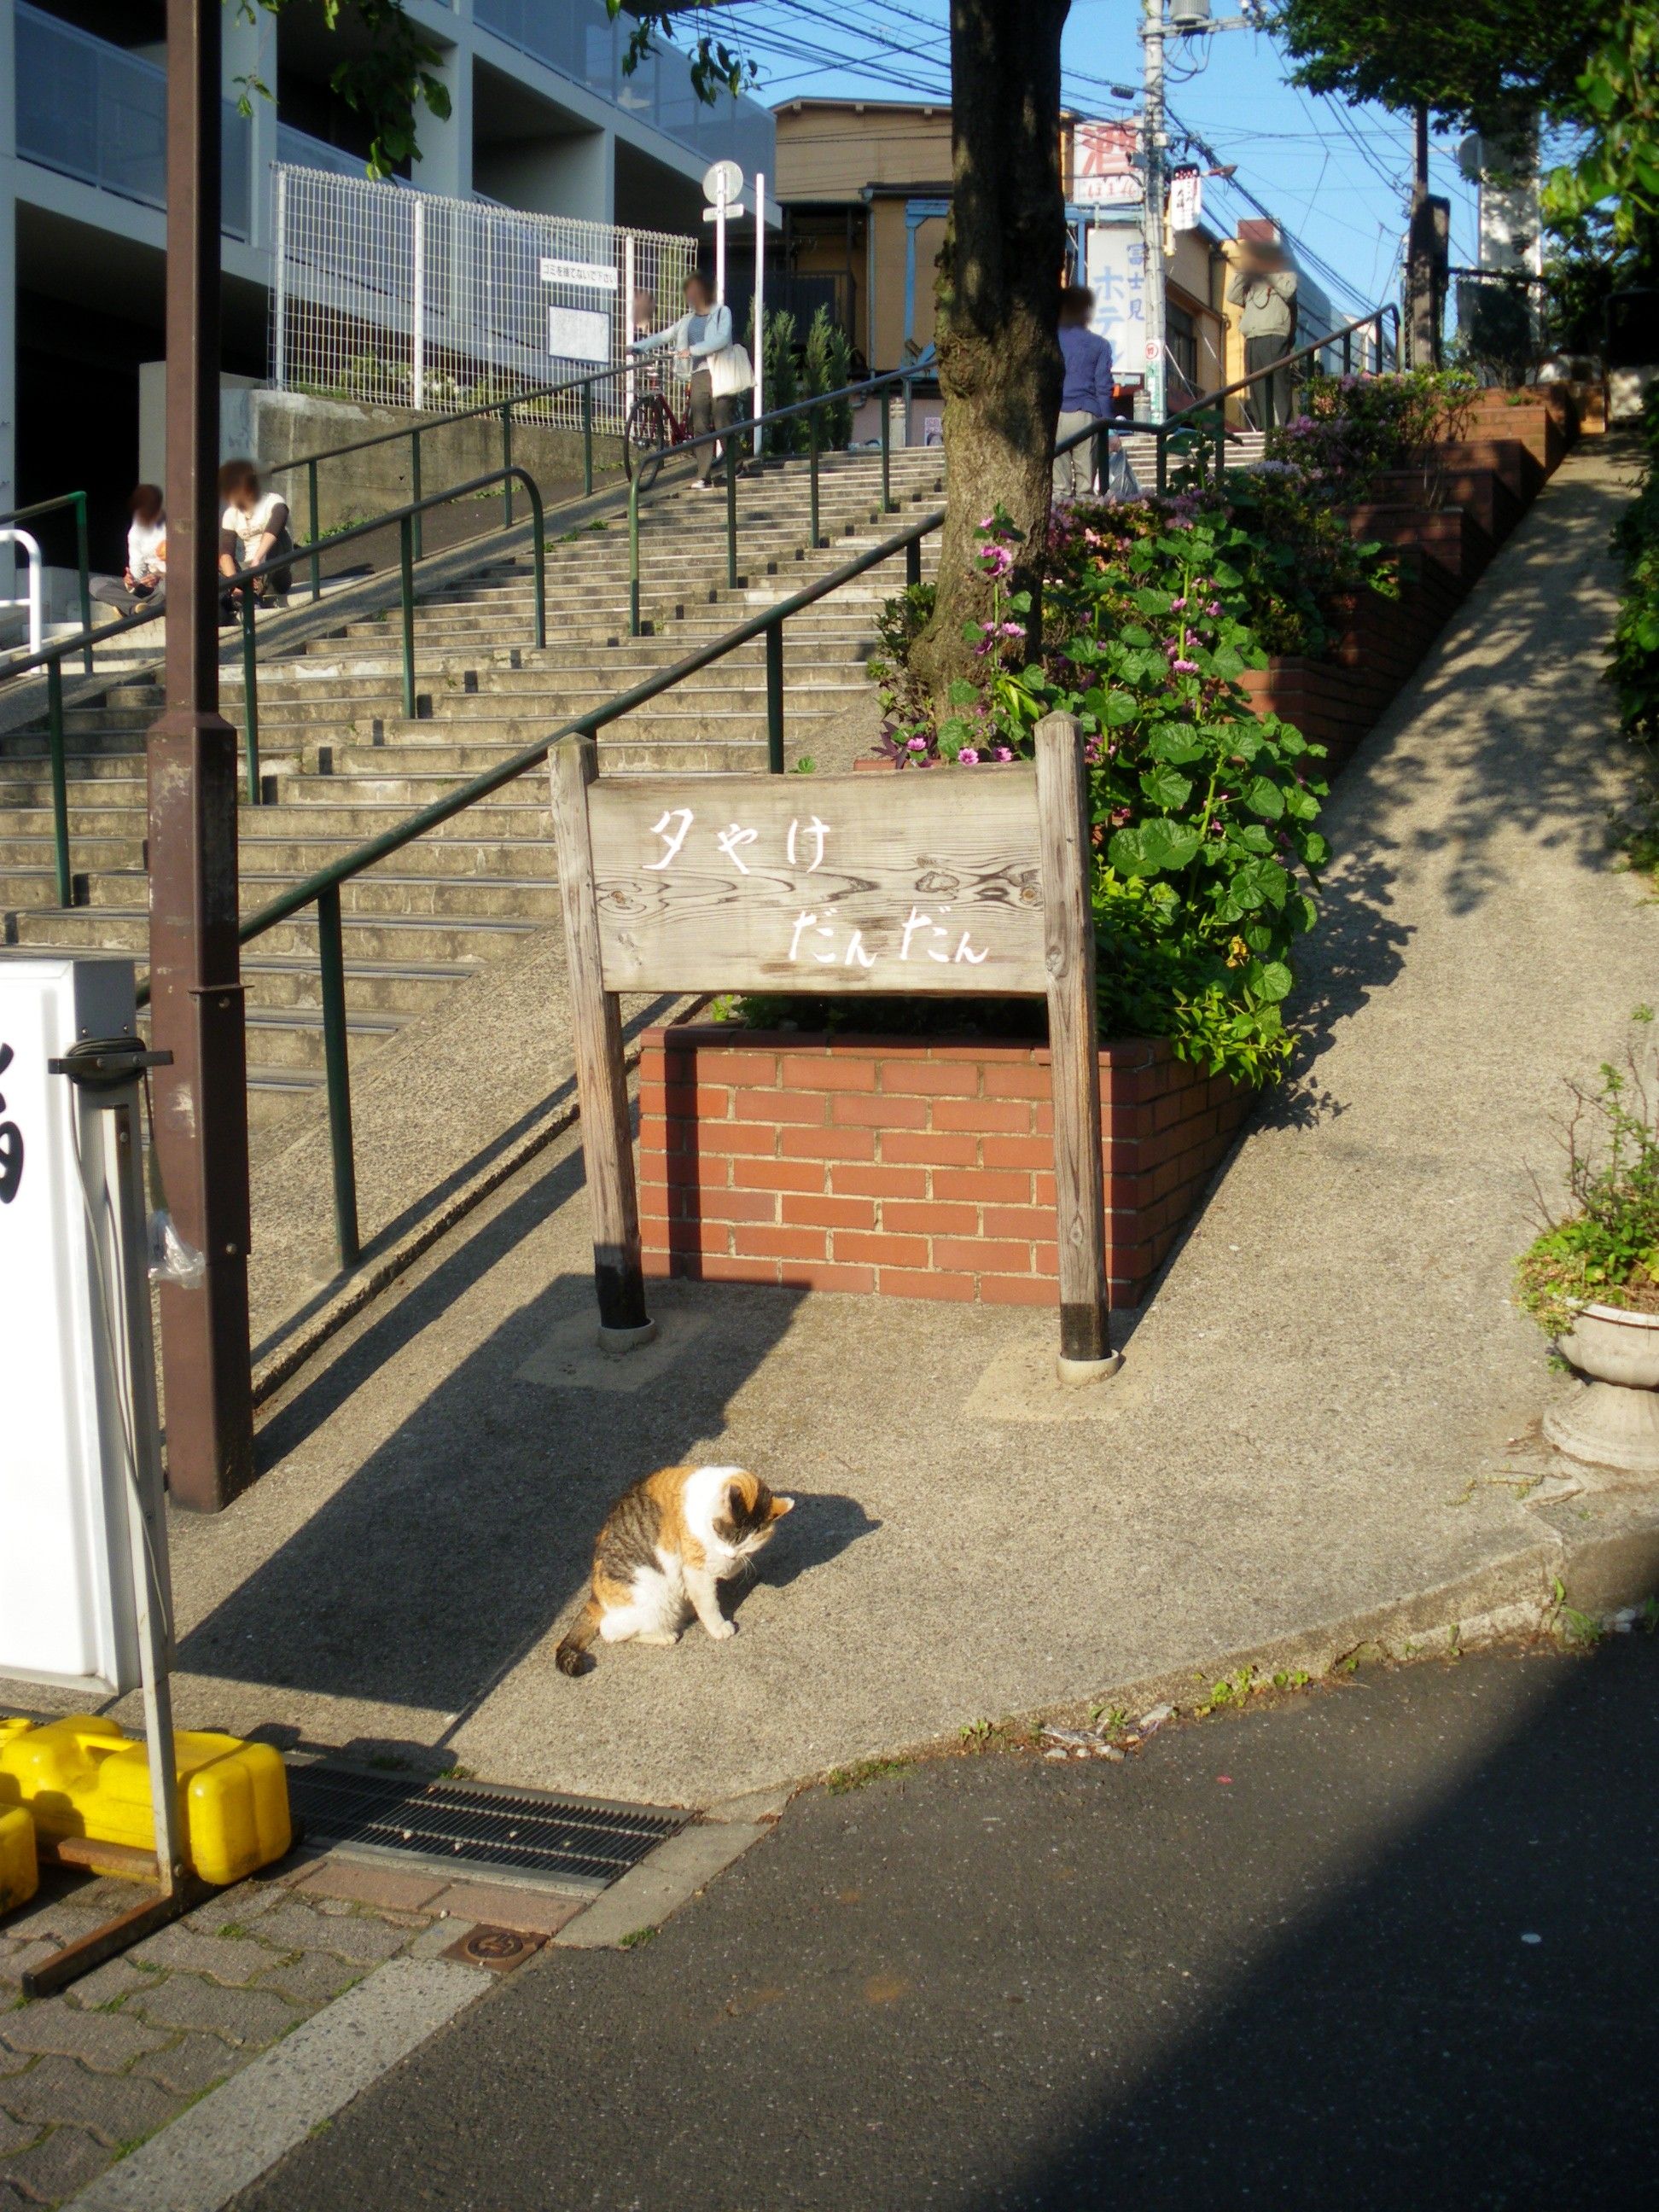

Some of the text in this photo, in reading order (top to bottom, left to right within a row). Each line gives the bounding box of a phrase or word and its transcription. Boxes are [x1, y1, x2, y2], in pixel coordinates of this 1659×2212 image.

[1081, 122, 1137, 176] 酒
[543, 264, 614, 283] ゴミを捨てないで下さい
[642, 807, 830, 874] 夕やけ
[789, 905, 989, 969] だんだん
